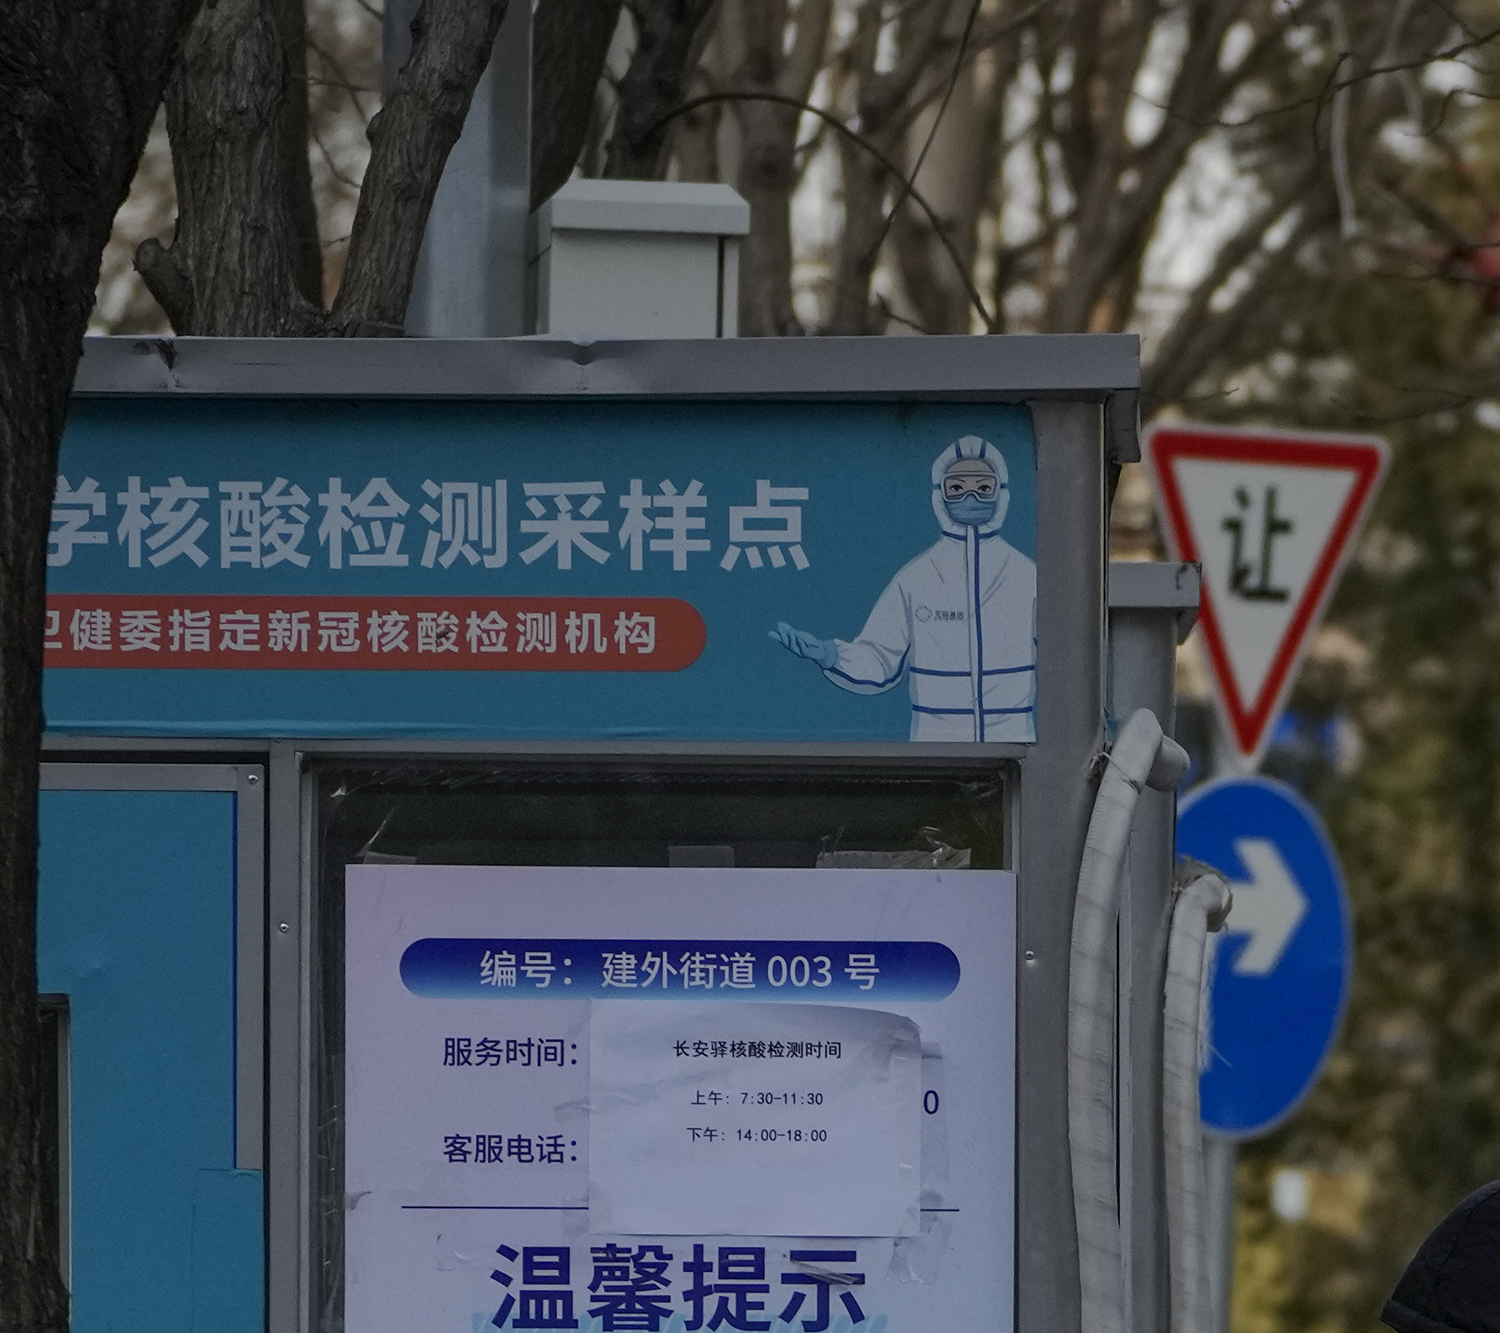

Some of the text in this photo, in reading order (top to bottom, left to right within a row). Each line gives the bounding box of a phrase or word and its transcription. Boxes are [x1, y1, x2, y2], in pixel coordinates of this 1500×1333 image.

[46, 475, 812, 573] 学核酸检测采样点
[1220, 485, 1294, 602] 让
[442, 1036, 580, 1068] 服务时间：
[672, 1039, 842, 1059] 长安驿核酸检测时间
[442, 1133, 580, 1165] 客服电话：
[491, 1242, 867, 1333] 温馨提示
